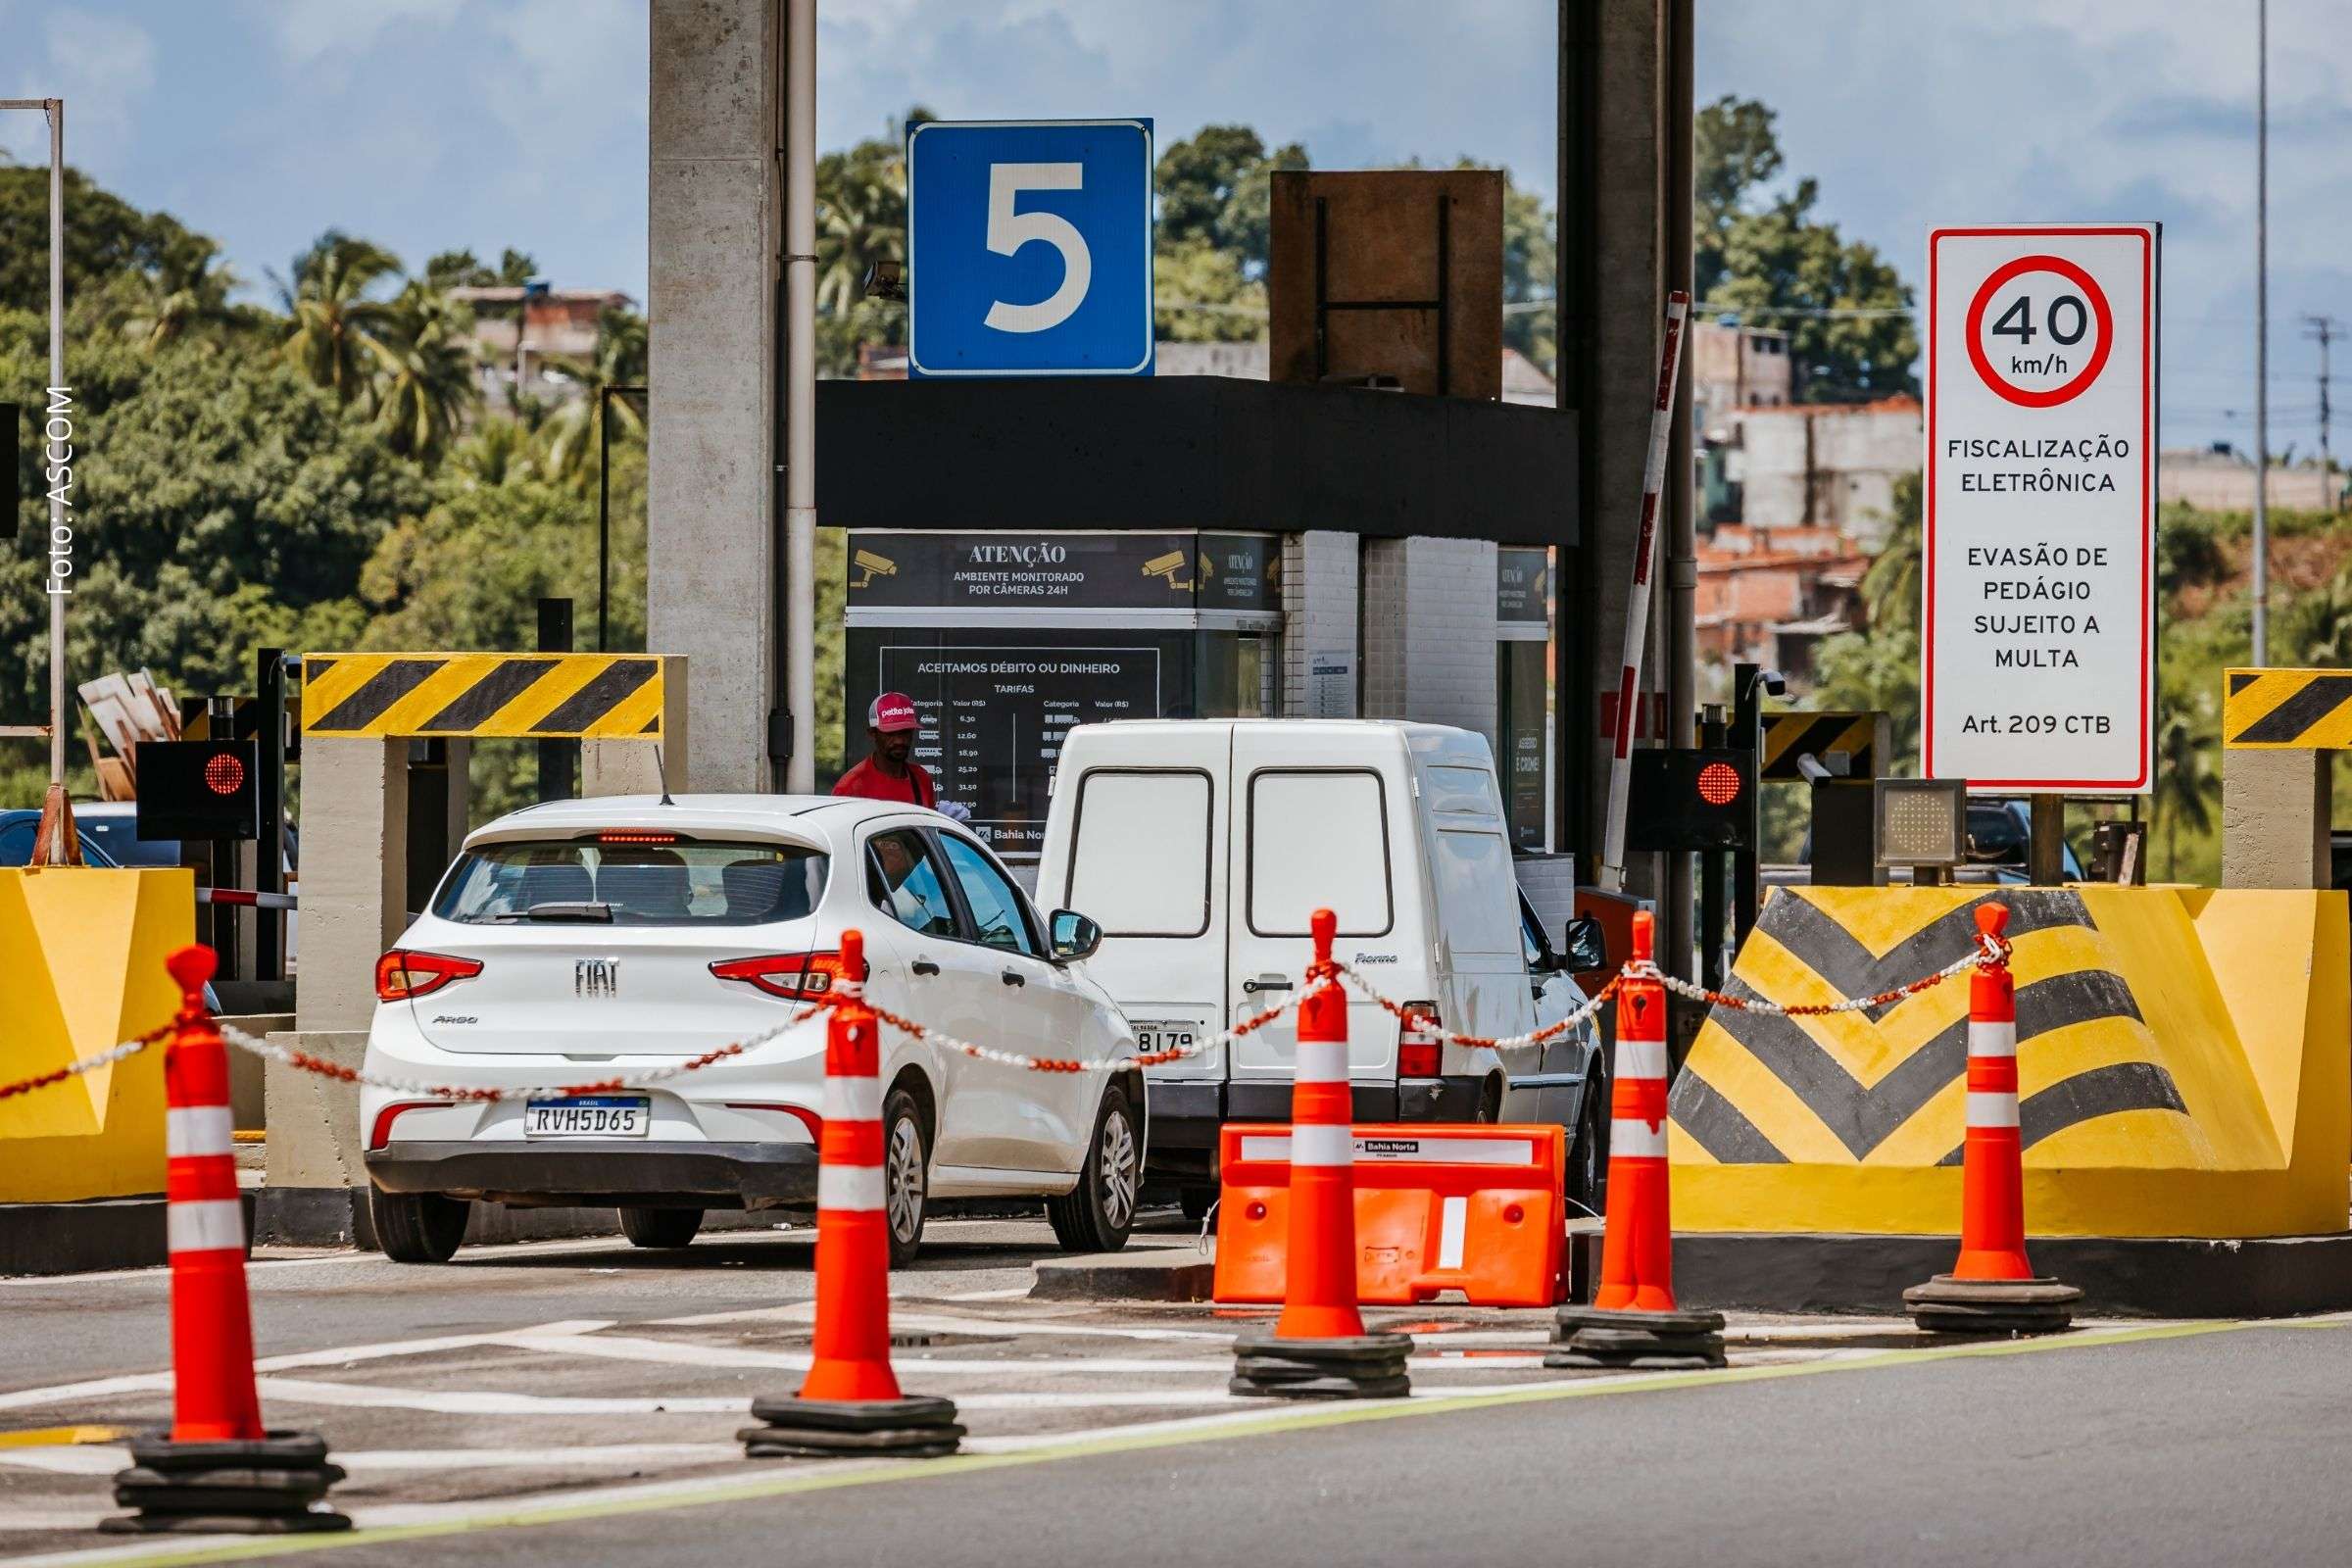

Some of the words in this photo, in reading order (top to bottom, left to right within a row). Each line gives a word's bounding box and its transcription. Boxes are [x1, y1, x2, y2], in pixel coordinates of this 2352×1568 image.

[984, 162, 1092, 333] 5
[1991, 294, 2088, 346] 40
[2011, 354, 2068, 375] km/h
[1947, 434, 2131, 463] FISCALIZAÇÃO
[1961, 467, 2116, 492] ELETRÔNICA
[968, 542, 1066, 567] ATENÇÃO
[1968, 542, 2069, 566] EVASÃO
[2076, 547, 2108, 566] DE
[954, 571, 1009, 582] AMBIENTE
[1011, 571, 1085, 583] MONITORADO
[968, 585, 991, 595] POR
[993, 582, 1045, 595] CÂMERAS
[1046, 585, 1069, 595] 24H
[1984, 575, 2091, 601] PEDÁGIO
[1974, 614, 2076, 634] SUJEITO
[2082, 615, 2100, 634] A
[917, 662, 988, 673] ACEITAMOS
[990, 661, 1036, 674] DÉBITO
[1039, 662, 1057, 674] OU
[1059, 663, 1121, 674] DINHEIRO
[1995, 649, 2080, 668] MULTA
[995, 684, 1035, 694] TARIFAS
[911, 700, 944, 709] ategoria
[1043, 700, 1080, 709] Categoria
[1962, 715, 2002, 734] Art.
[2008, 715, 2057, 734] 209
[2064, 715, 2111, 734] CTB
[994, 829, 1025, 840] Bahia
[574, 956, 620, 998] FIAT
[1139, 1032, 1193, 1053] 8179
[536, 1108, 636, 1131] RVH5D65
[1367, 1142, 1391, 1152] Bahia
[1392, 1142, 1416, 1152] Norte
